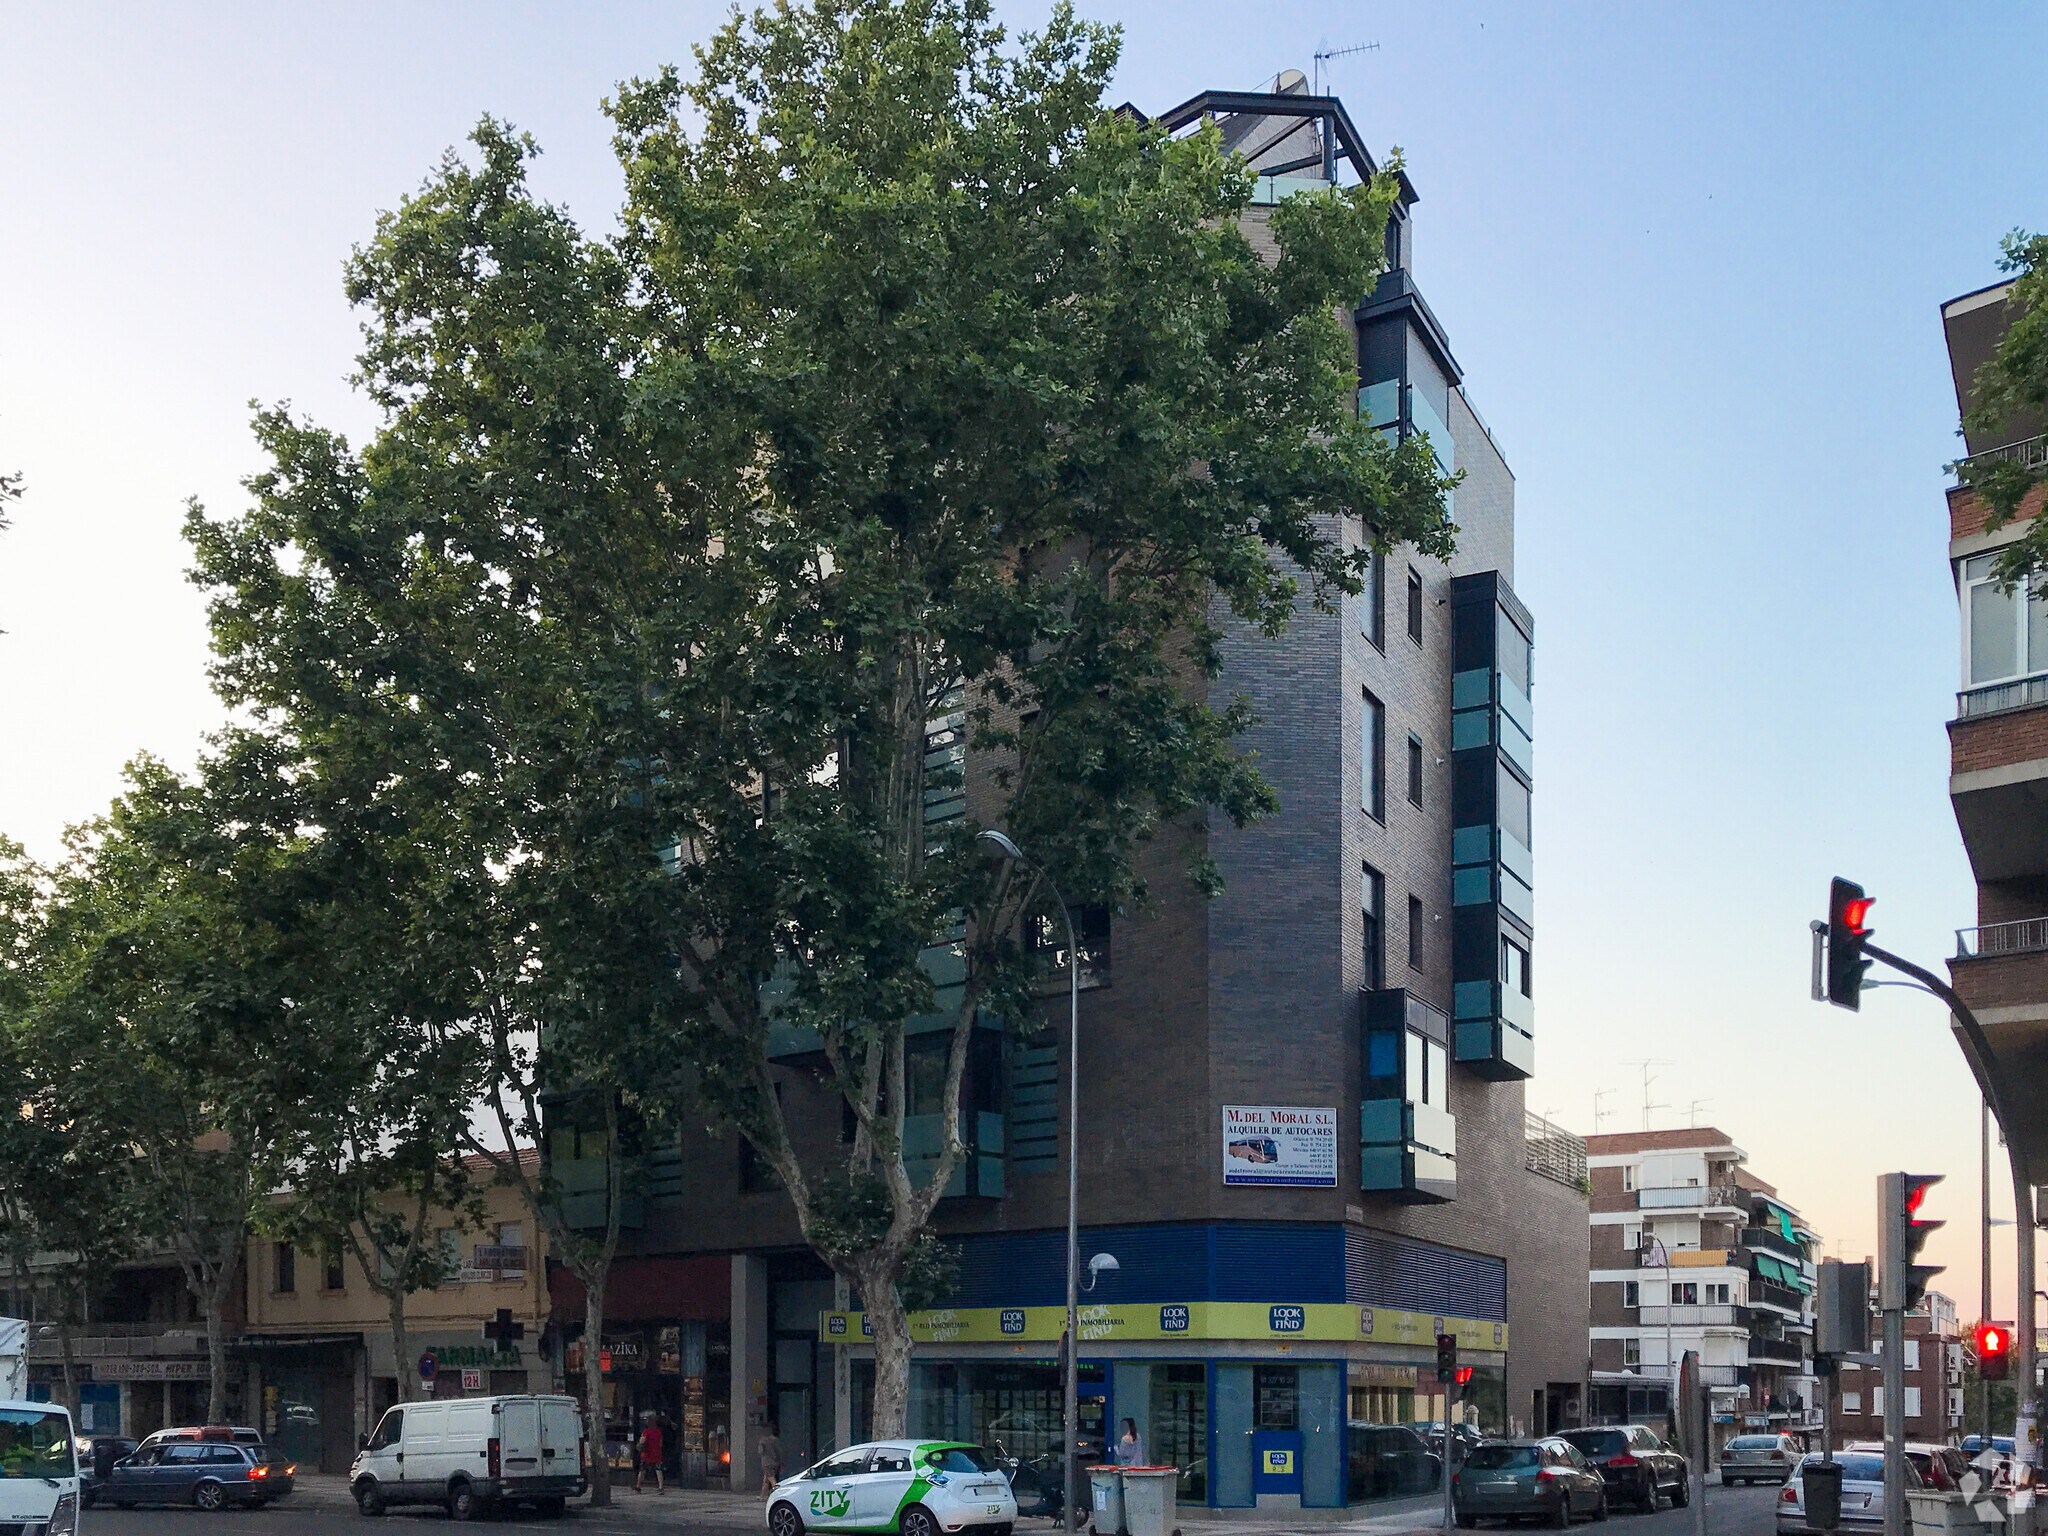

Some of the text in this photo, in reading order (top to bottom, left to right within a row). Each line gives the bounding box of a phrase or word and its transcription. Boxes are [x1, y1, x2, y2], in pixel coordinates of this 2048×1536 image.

[1228, 1109, 1333, 1125] M. DEL MORAL S.L.
[1227, 1125, 1333, 1136] ALQUILER DE AUTOCARES
[1003, 1312, 1023, 1320] LOOK
[1163, 1307, 1186, 1317] LOOK
[1273, 1308, 1301, 1317] LOOK
[1004, 1323, 1022, 1331] FIND
[1080, 1318, 1125, 1326] INMOBILIARIA
[1164, 1319, 1185, 1329] FIND
[1275, 1320, 1300, 1329] FIND
[166, 1363, 192, 1373] HIPER
[463, 1376, 472, 1388] 12
[810, 1490, 848, 1508] ZITY
